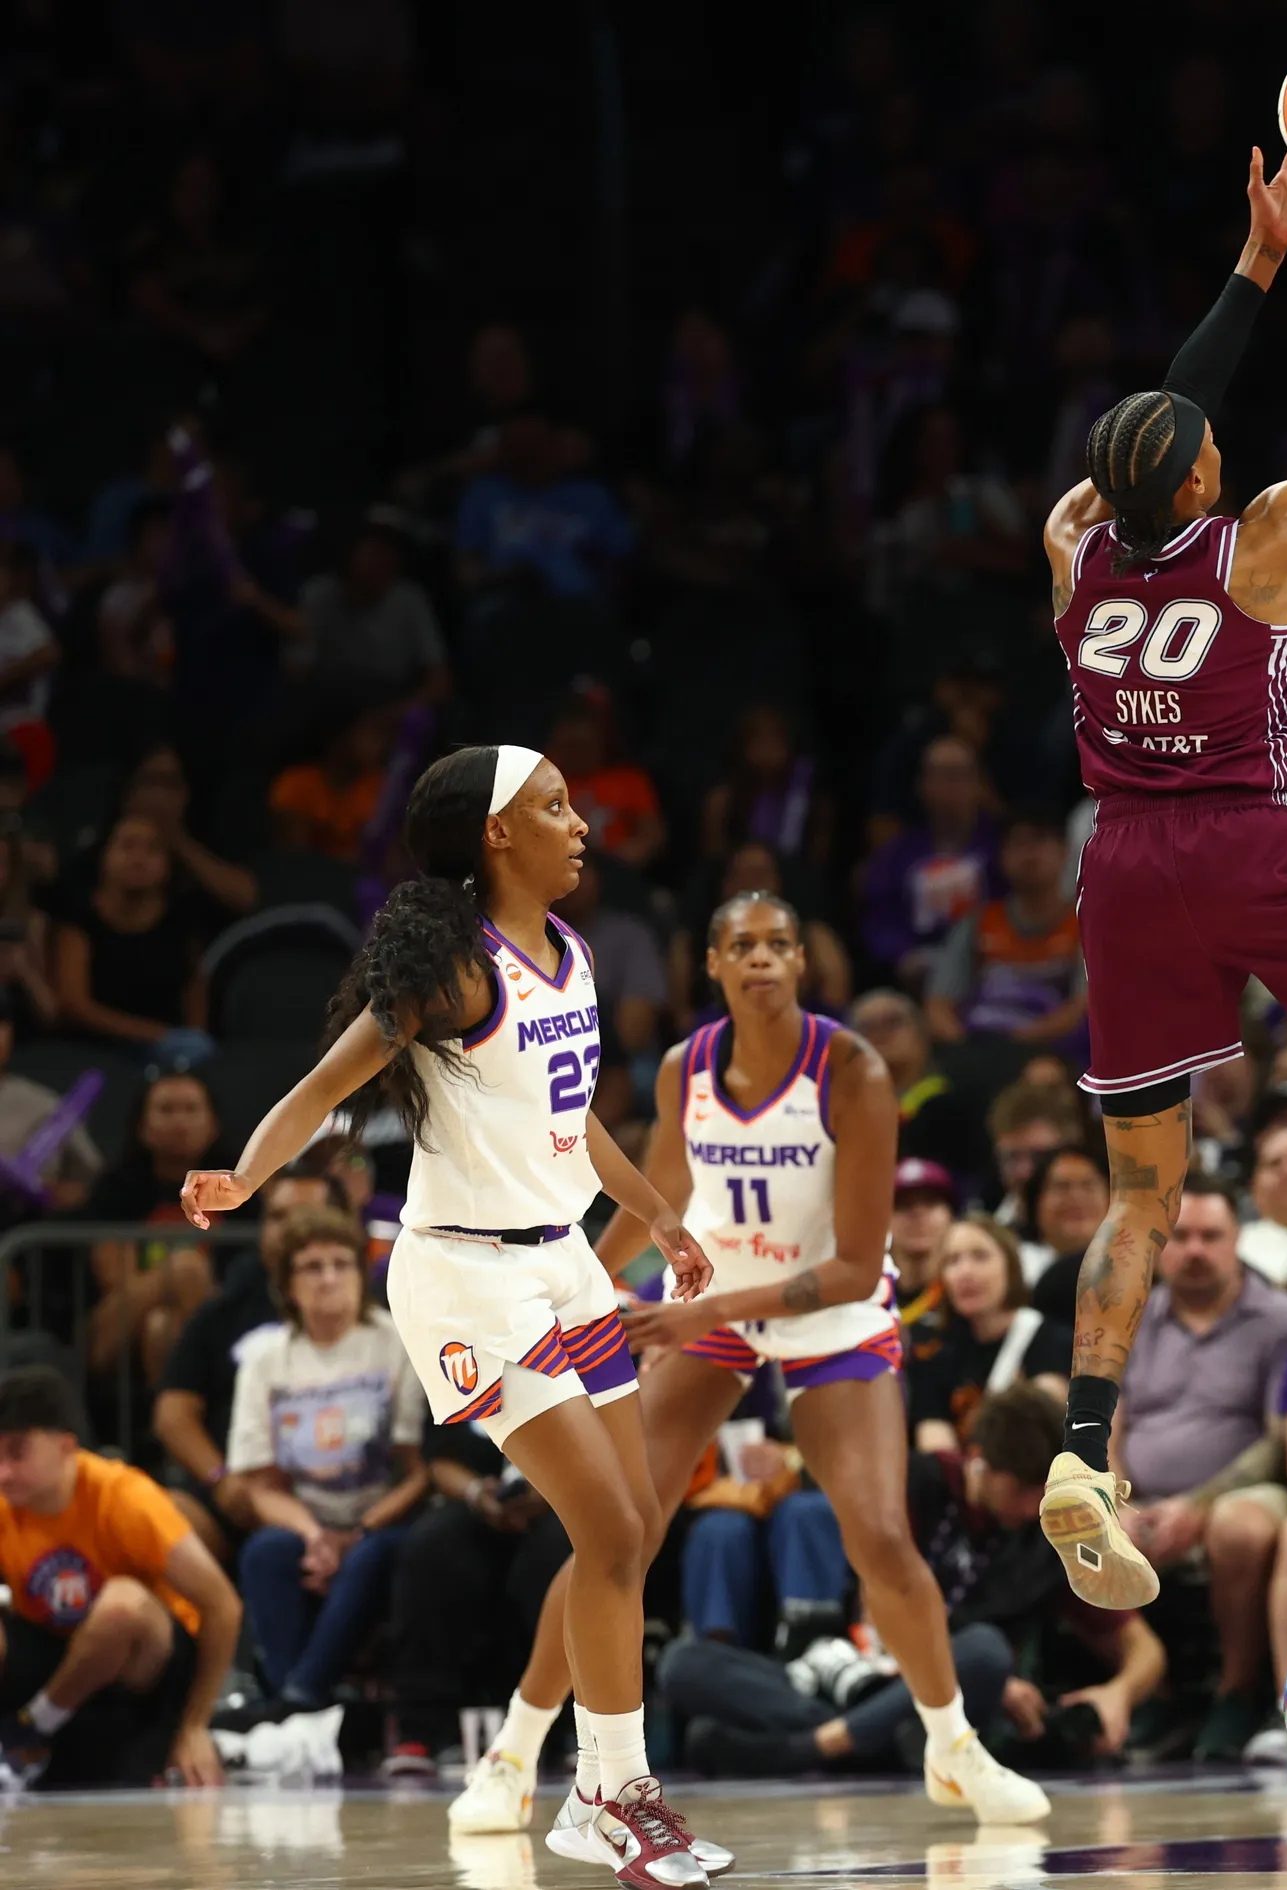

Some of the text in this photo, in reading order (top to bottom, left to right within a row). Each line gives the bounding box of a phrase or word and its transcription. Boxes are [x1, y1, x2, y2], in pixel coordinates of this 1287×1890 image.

[1078, 598, 1222, 681] 20
[1115, 689, 1182, 725] SYKES
[1141, 735, 1208, 754] AT&T
[517, 1004, 600, 1053] MERCUR
[689, 1142, 821, 1168] MERCURY
[726, 1178, 771, 1224] 11
